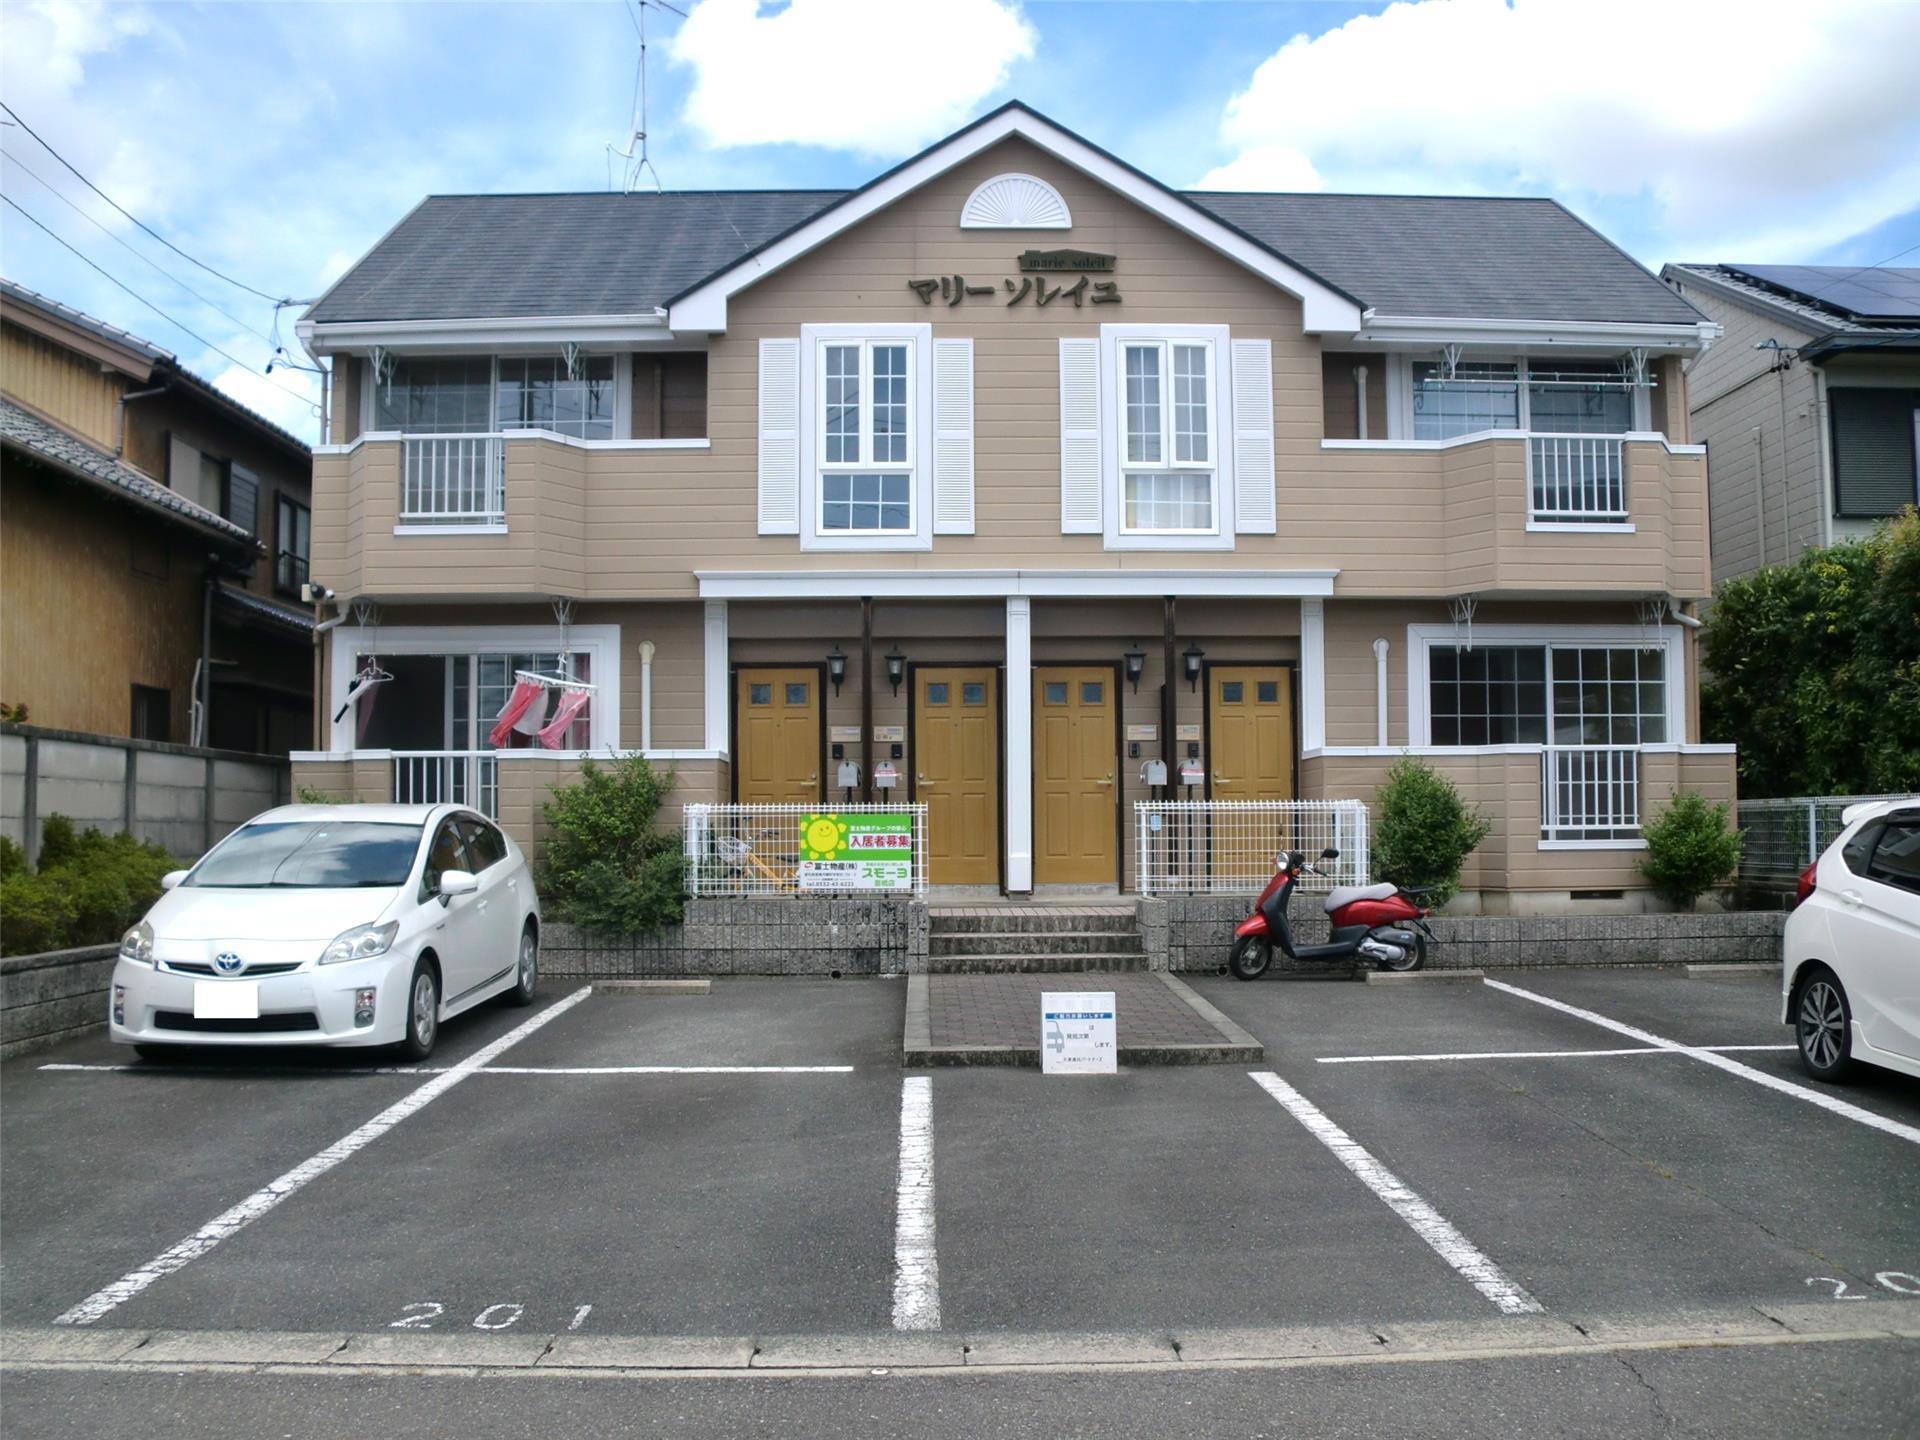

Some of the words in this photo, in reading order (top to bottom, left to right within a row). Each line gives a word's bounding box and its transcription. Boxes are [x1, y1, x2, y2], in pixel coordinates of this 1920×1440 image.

[1029, 256, 1065, 268] marie
[1072, 256, 1106, 268] soleil
[850, 835, 911, 848] 入居者募集
[388, 1302, 593, 1331] 201
